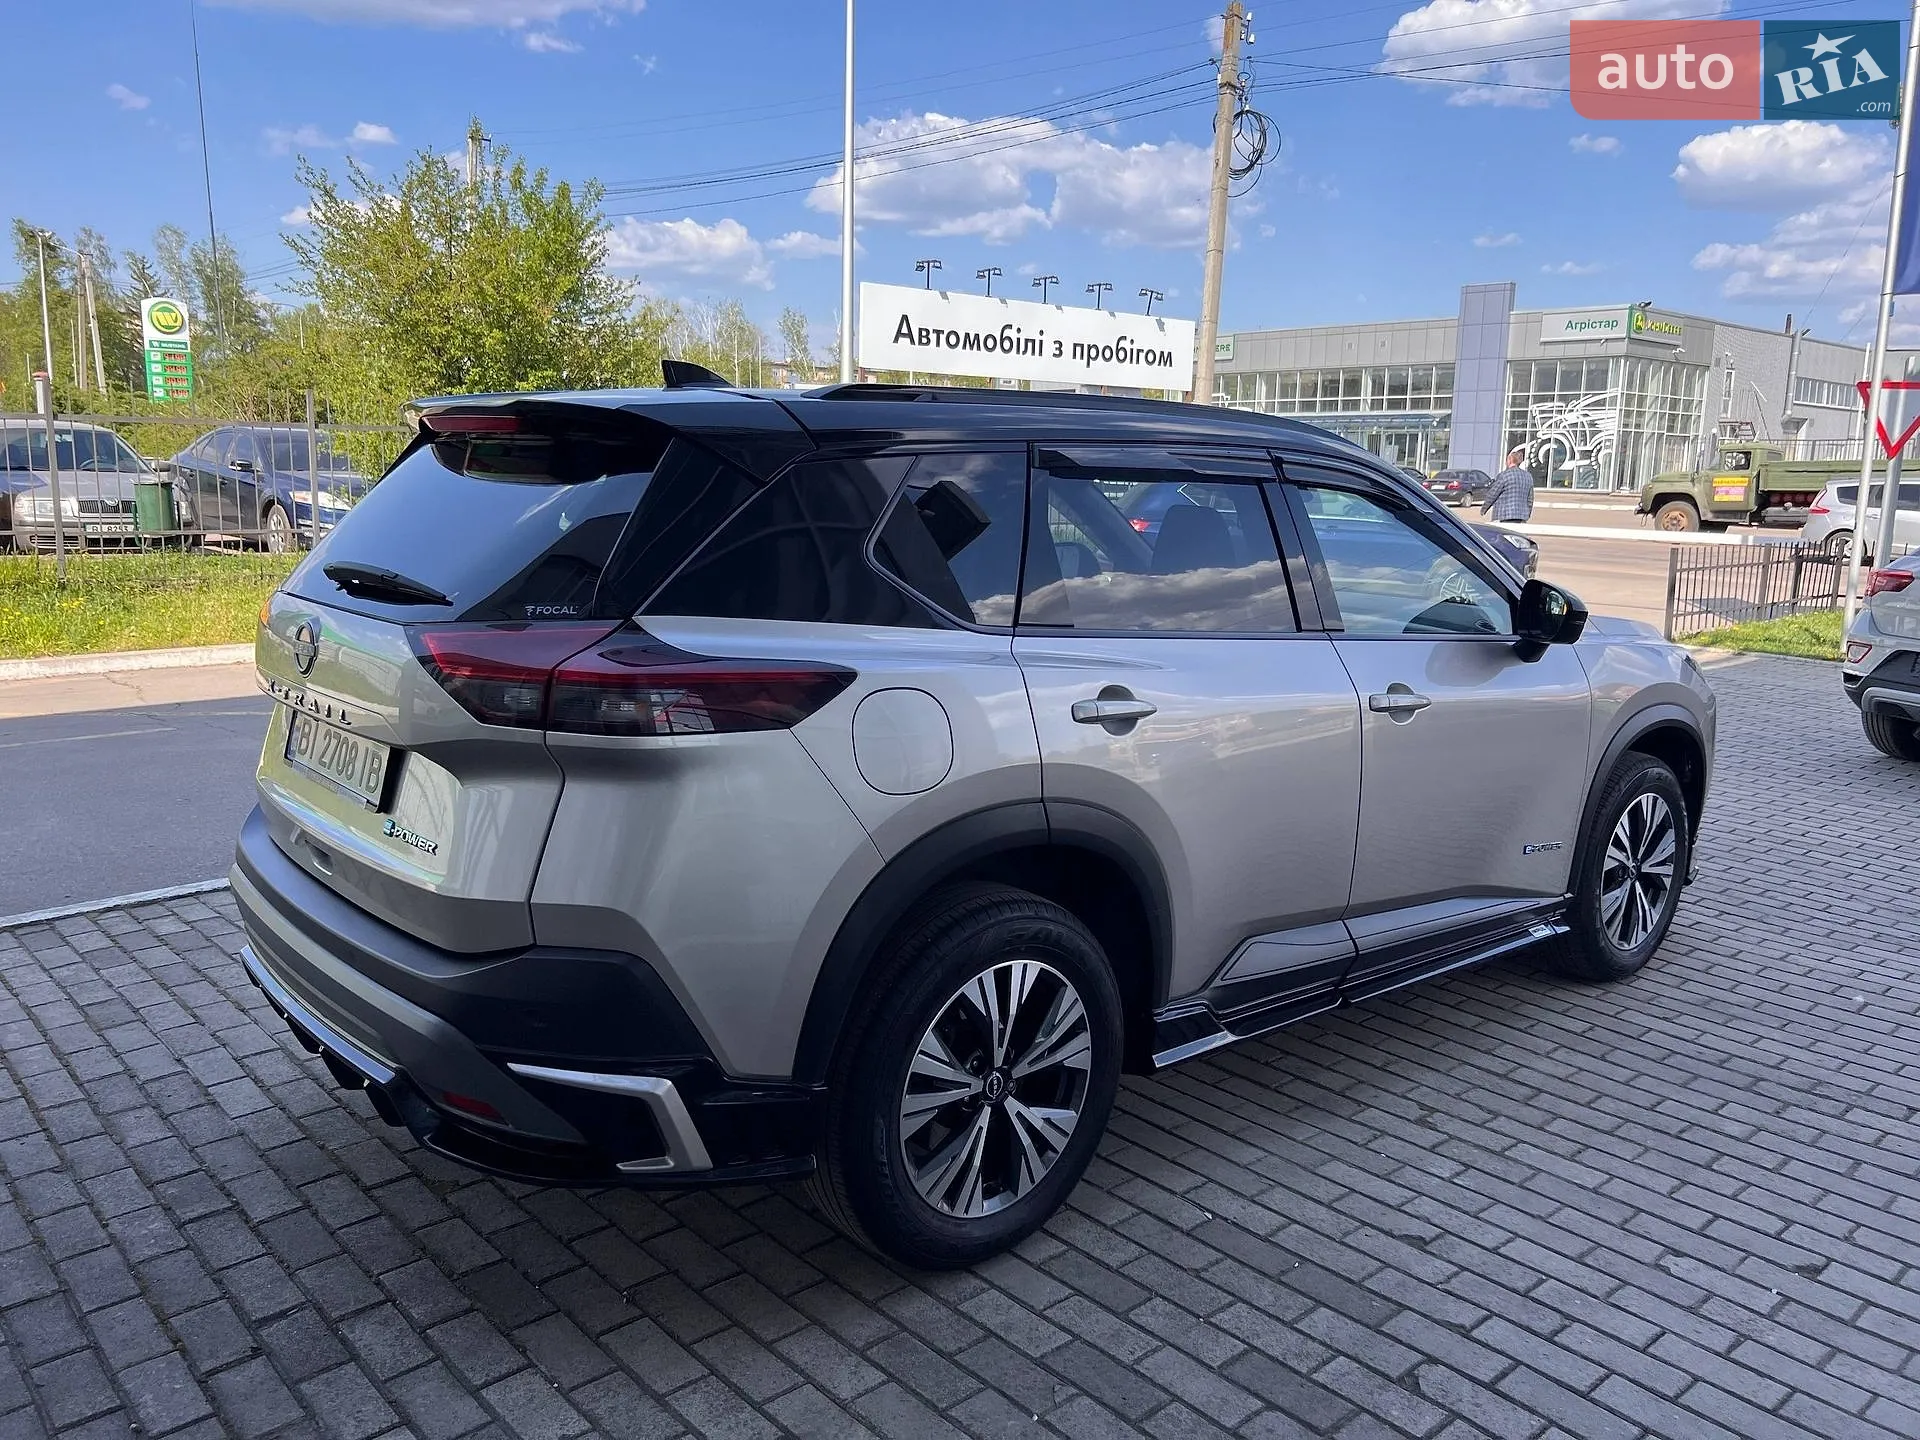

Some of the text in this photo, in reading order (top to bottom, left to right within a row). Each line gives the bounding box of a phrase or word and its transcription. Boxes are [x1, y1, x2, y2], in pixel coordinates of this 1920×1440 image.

[892, 314, 1174, 369] Автомобілі з пробігом
[1564, 319, 1619, 332] Агрістар
[536, 605, 578, 616] FOCAL
[318, 728, 359, 781] 2708
